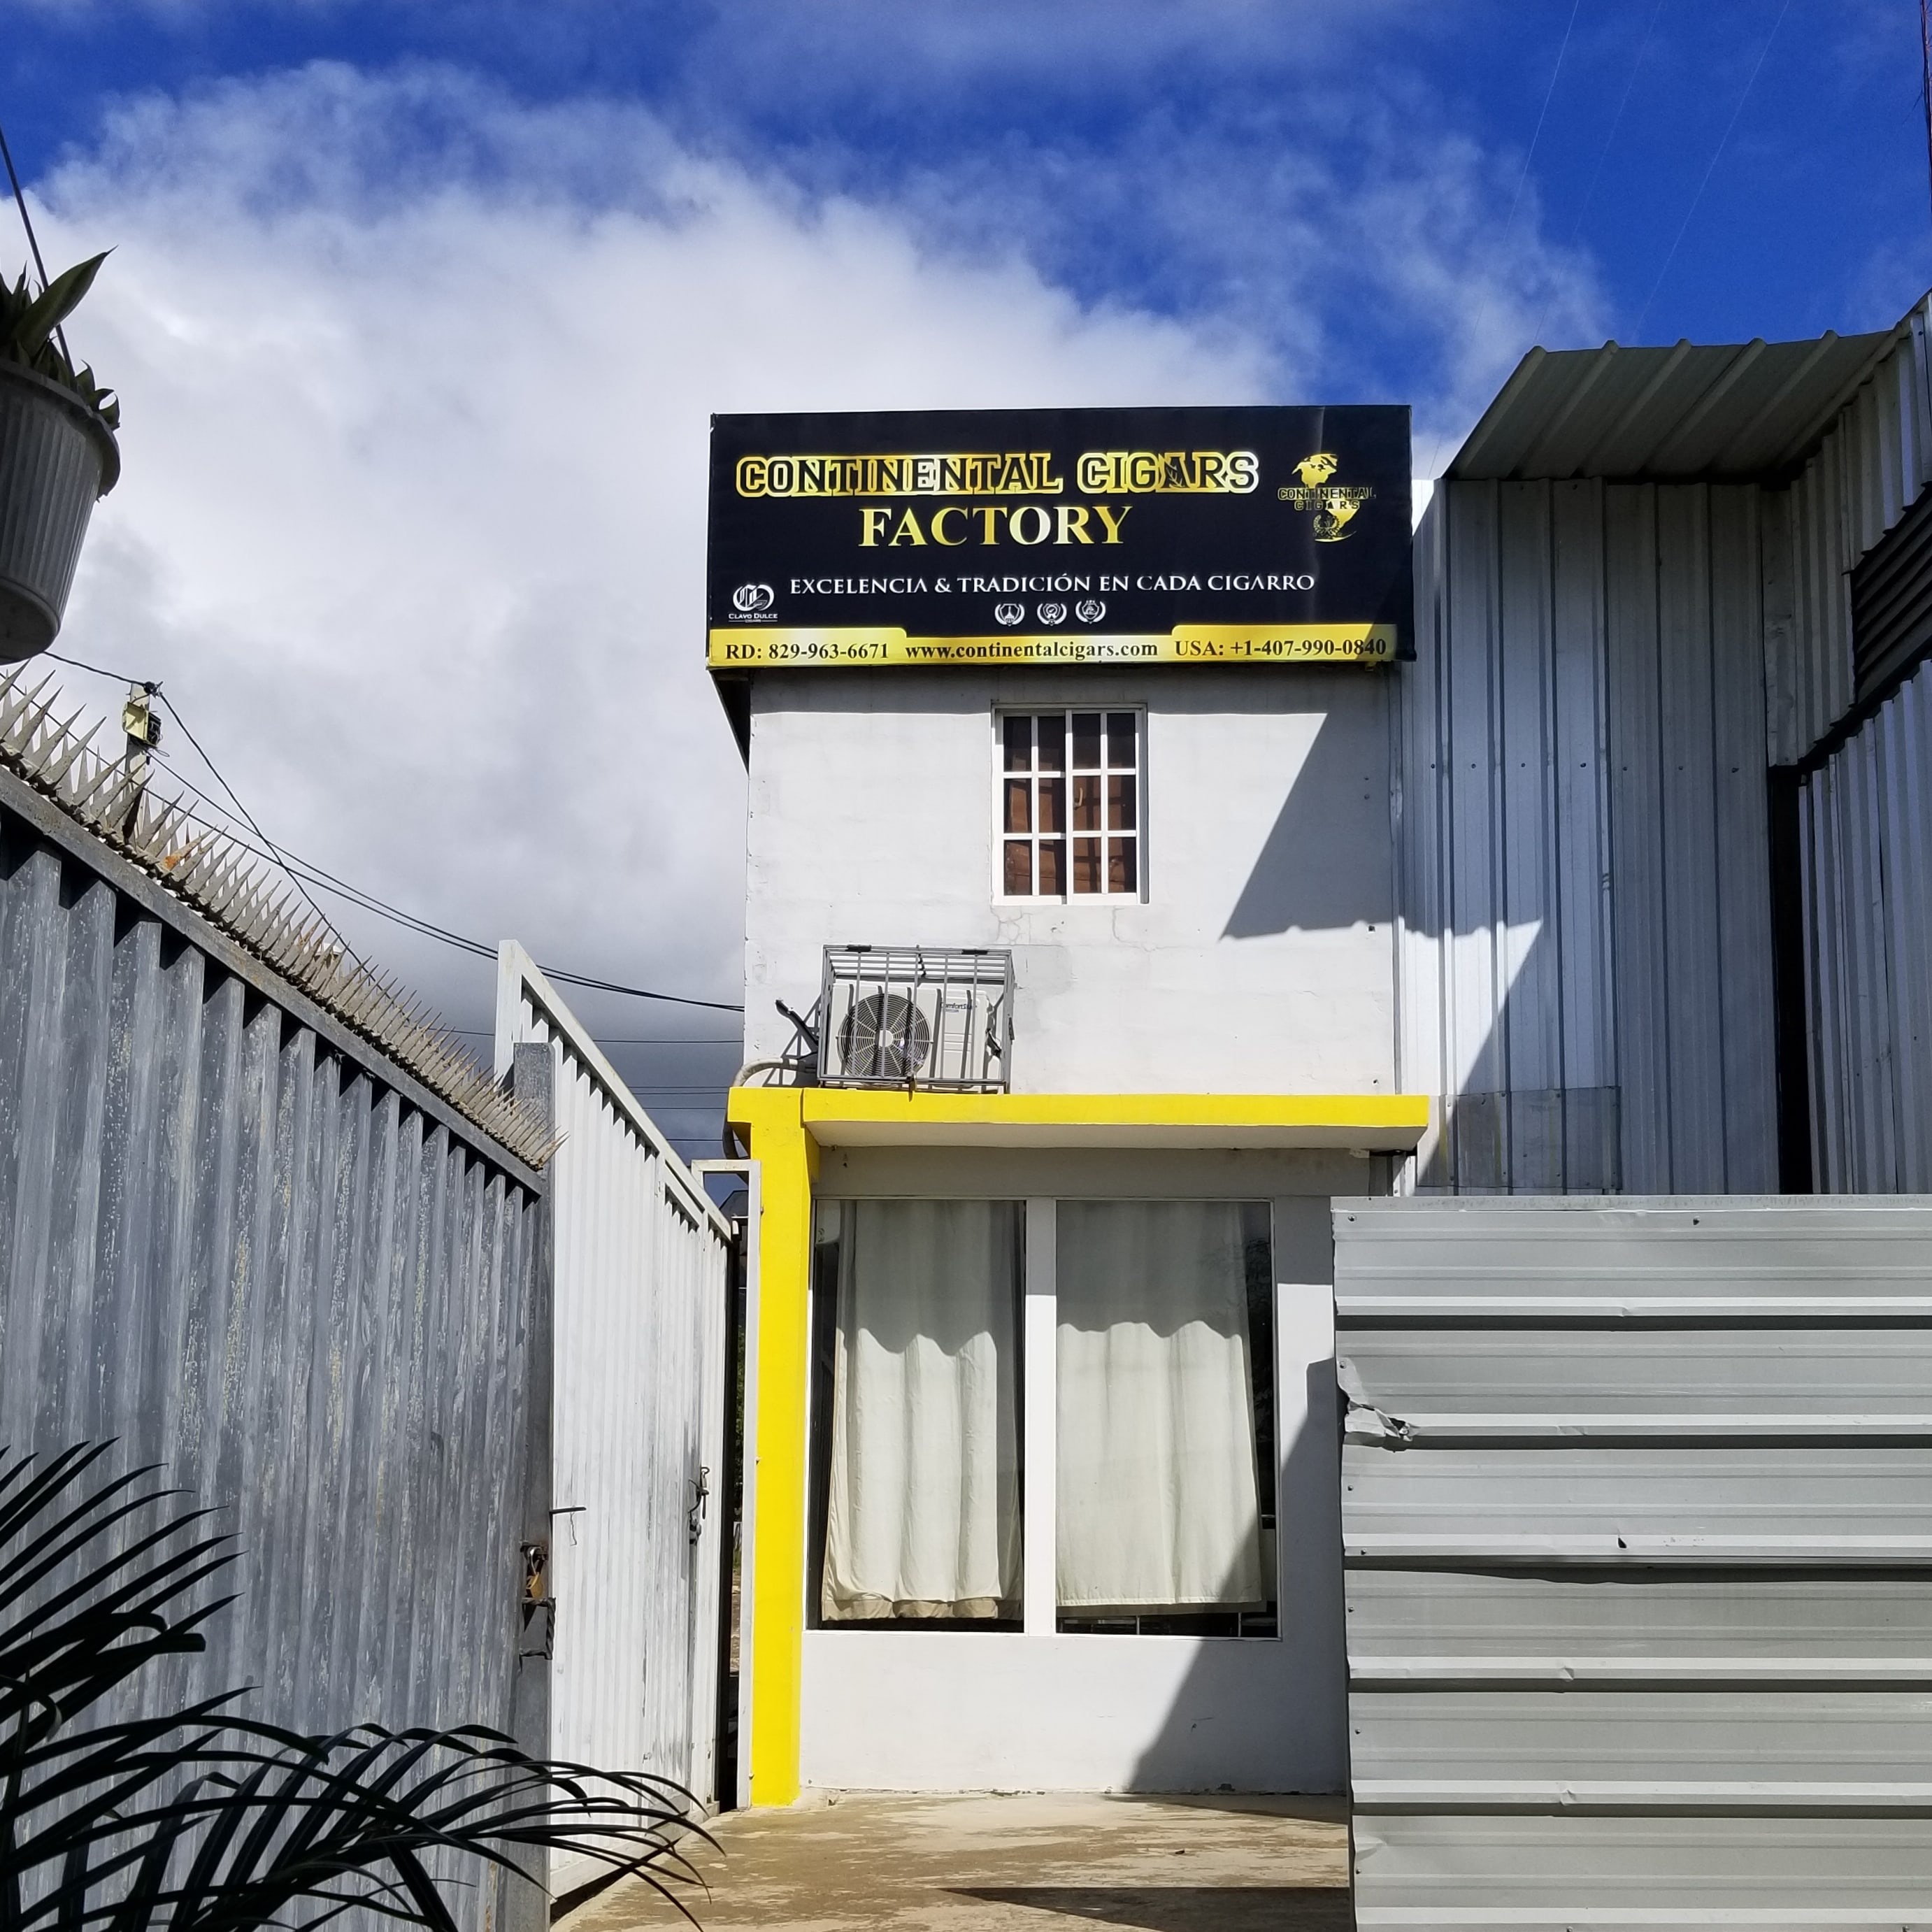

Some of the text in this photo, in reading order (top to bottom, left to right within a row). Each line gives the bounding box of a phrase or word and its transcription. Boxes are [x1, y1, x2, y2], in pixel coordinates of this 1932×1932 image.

[736, 451, 1259, 497] CONTINENTAL CIGARS
[1278, 487, 1376, 501] CONTINENTAL
[1294, 500, 1360, 510] CIGARS
[858, 506, 1133, 546] FACTORY
[790, 573, 1315, 594] EXCELENCIA & TRADICIÓN EN CADA CIGARRO
[725, 638, 1387, 660] RD: 829-963-6671 www.continentalcigars.com USA: +1-407-990-0840
